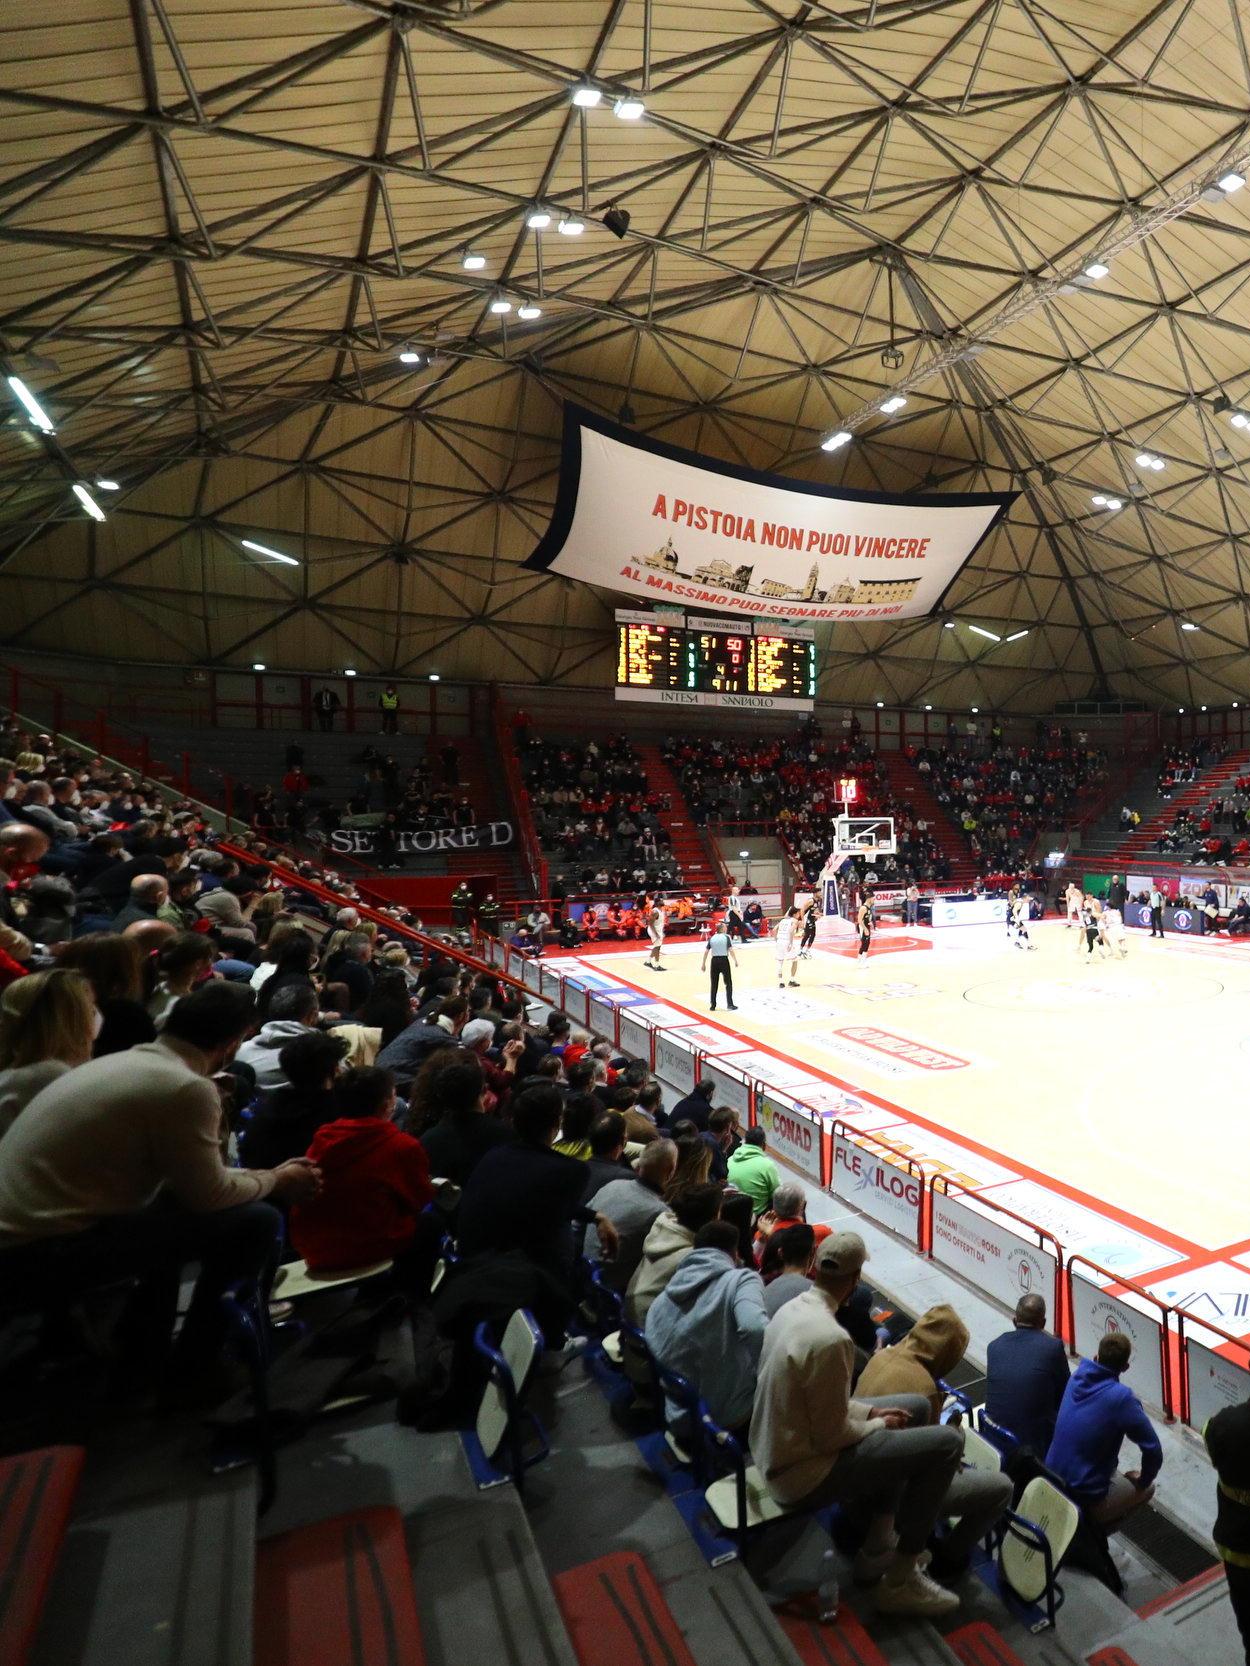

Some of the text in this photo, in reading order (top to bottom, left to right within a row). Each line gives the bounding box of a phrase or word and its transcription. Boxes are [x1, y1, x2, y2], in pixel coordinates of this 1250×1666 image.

[652, 494, 930, 559] A PISTOIA NON PUOI VINCERE
[619, 566, 642, 582] AL
[646, 575, 728, 605] MASSIMO
[729, 597, 766, 613] PUOI
[767, 605, 839, 618] SEGNARE
[701, 636, 742, 650] 51 50
[717, 665, 725, 675] 4
[661, 692, 773, 707] INTESA SANPAOLO
[330, 822, 513, 853] SETORE D
[773, 1111, 811, 1152] CONAD
[835, 1147, 920, 1206] FLEXILOG
[939, 1212, 958, 1230] DIVANI
[936, 1226, 985, 1264] SONO OFFERTI DA
